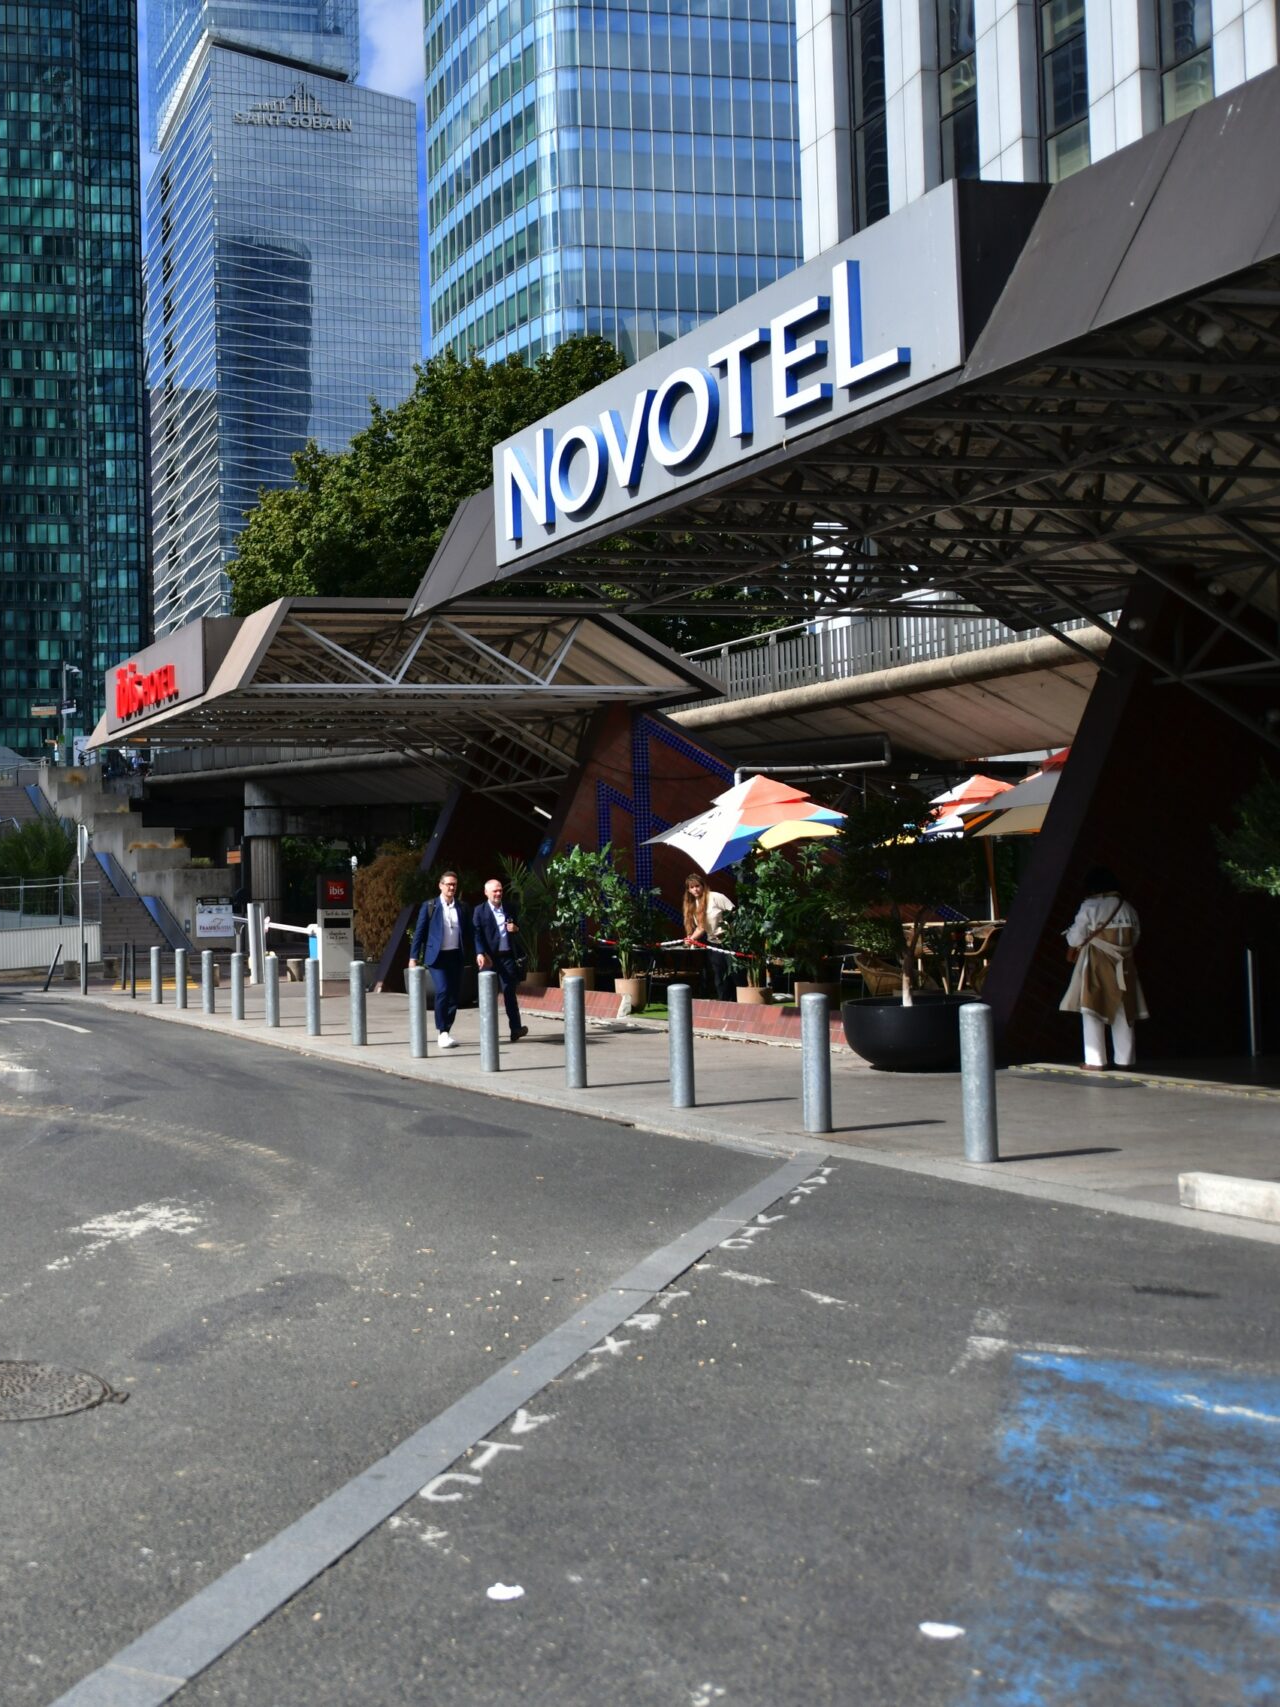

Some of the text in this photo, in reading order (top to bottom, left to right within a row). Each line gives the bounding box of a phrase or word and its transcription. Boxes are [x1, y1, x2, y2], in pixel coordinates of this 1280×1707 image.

[503, 260, 911, 541] NOVOTEL
[329, 886, 344, 895] ibis
[789, 1167, 839, 1205] TAXI
[574, 1290, 691, 1381] TAXI
